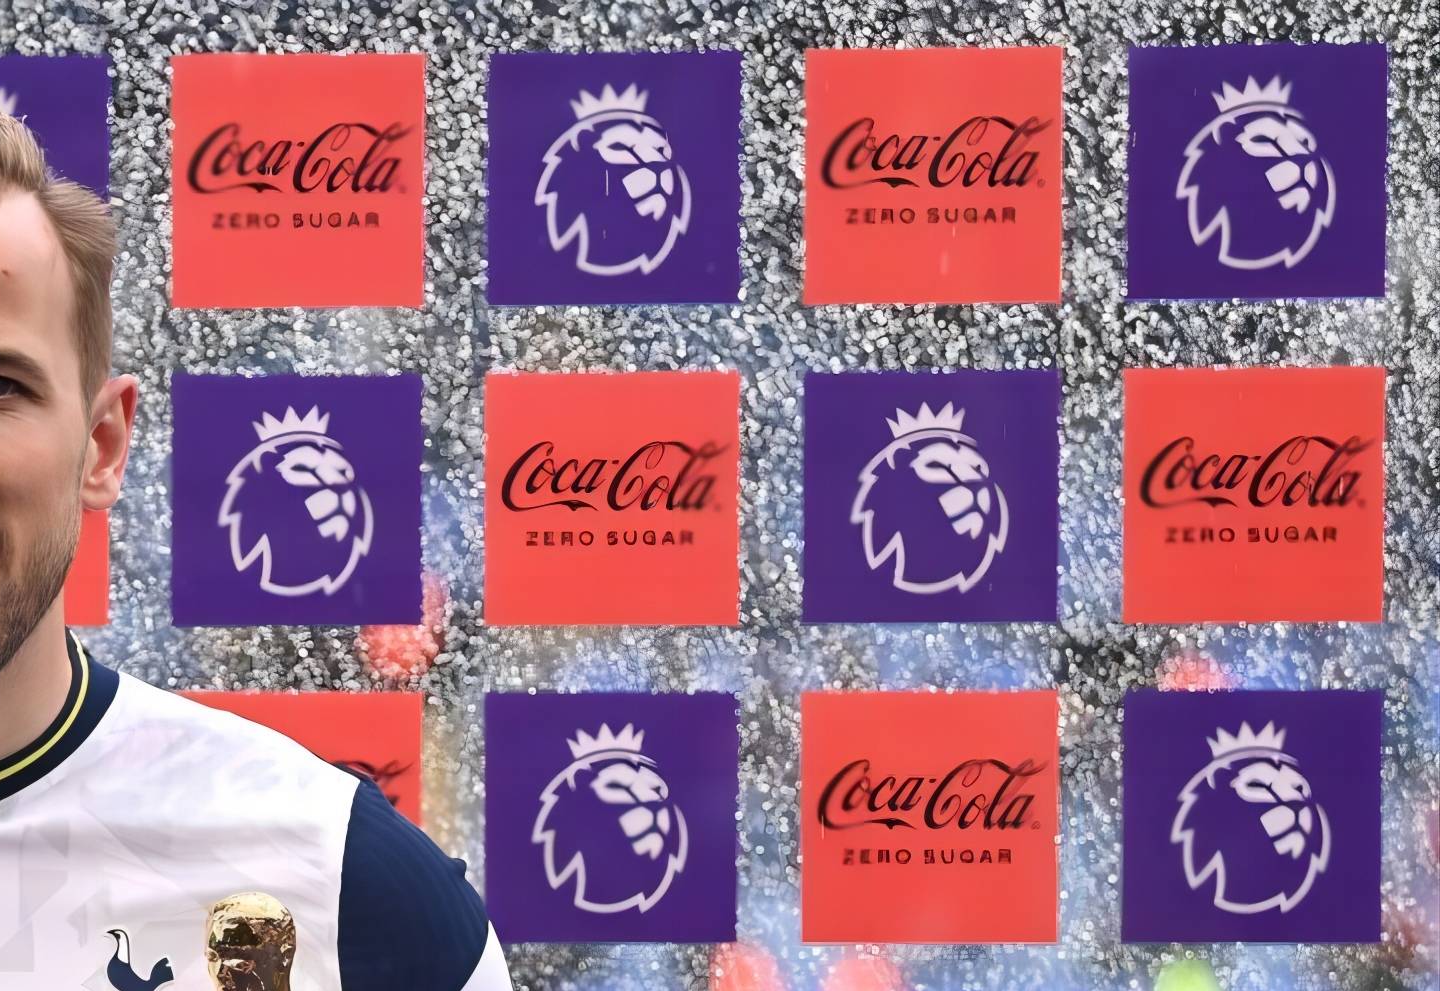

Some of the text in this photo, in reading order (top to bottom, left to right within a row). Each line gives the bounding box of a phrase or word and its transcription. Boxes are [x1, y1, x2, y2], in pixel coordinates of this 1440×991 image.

[185, 123, 414, 196] Coca-Cola
[819, 116, 1054, 192] Coca-Cola
[213, 212, 381, 230] ZERO SUGAR
[847, 207, 1017, 226] ZERO SUGAR
[500, 441, 730, 514] Coca-Cola
[1138, 436, 1374, 511] Coca-Cola
[527, 531, 695, 548] ZERO SUGAR
[1167, 526, 1339, 545] ZERO SUGAR
[816, 759, 1049, 832] Coca-Cola
[843, 849, 1013, 866] ZERO SUGAR
